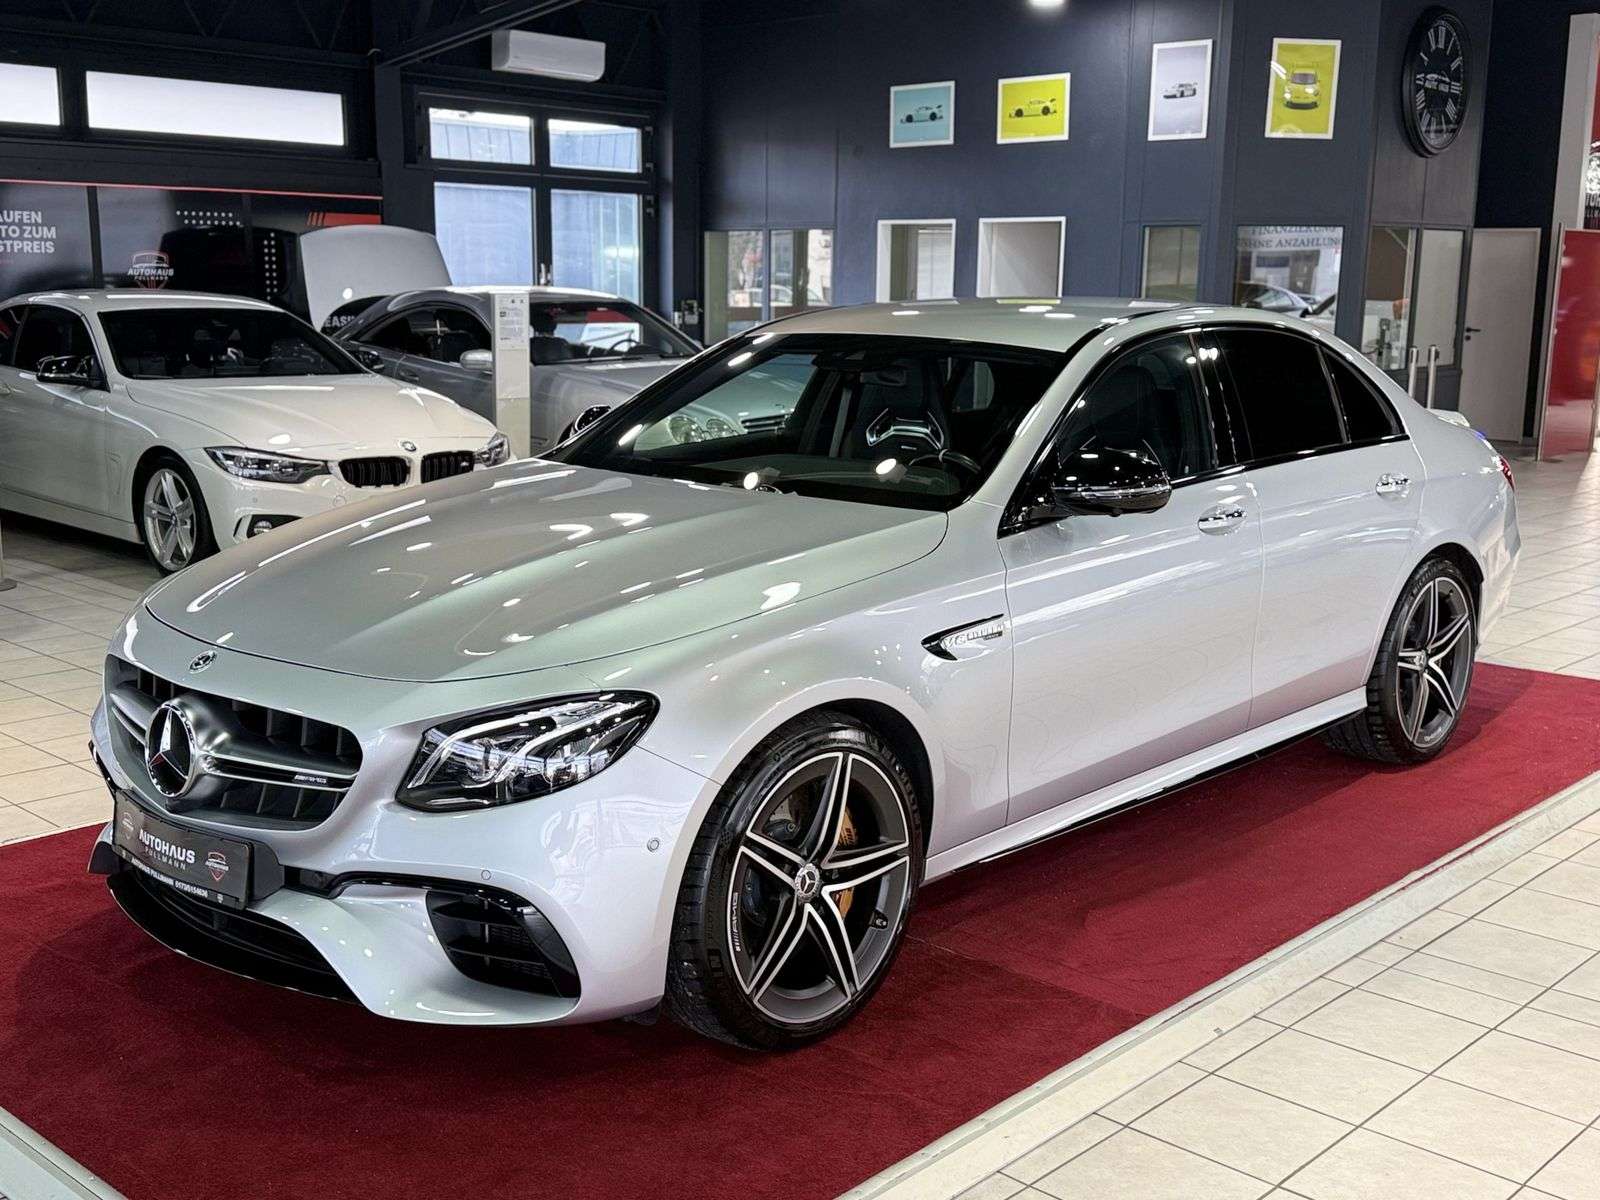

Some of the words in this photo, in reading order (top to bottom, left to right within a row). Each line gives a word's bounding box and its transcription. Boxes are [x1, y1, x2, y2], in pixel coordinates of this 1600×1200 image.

[22, 226, 56, 239] ZUM
[128, 268, 174, 276] AUTOHAUS
[139, 828, 196, 864] AUTOHAUS
